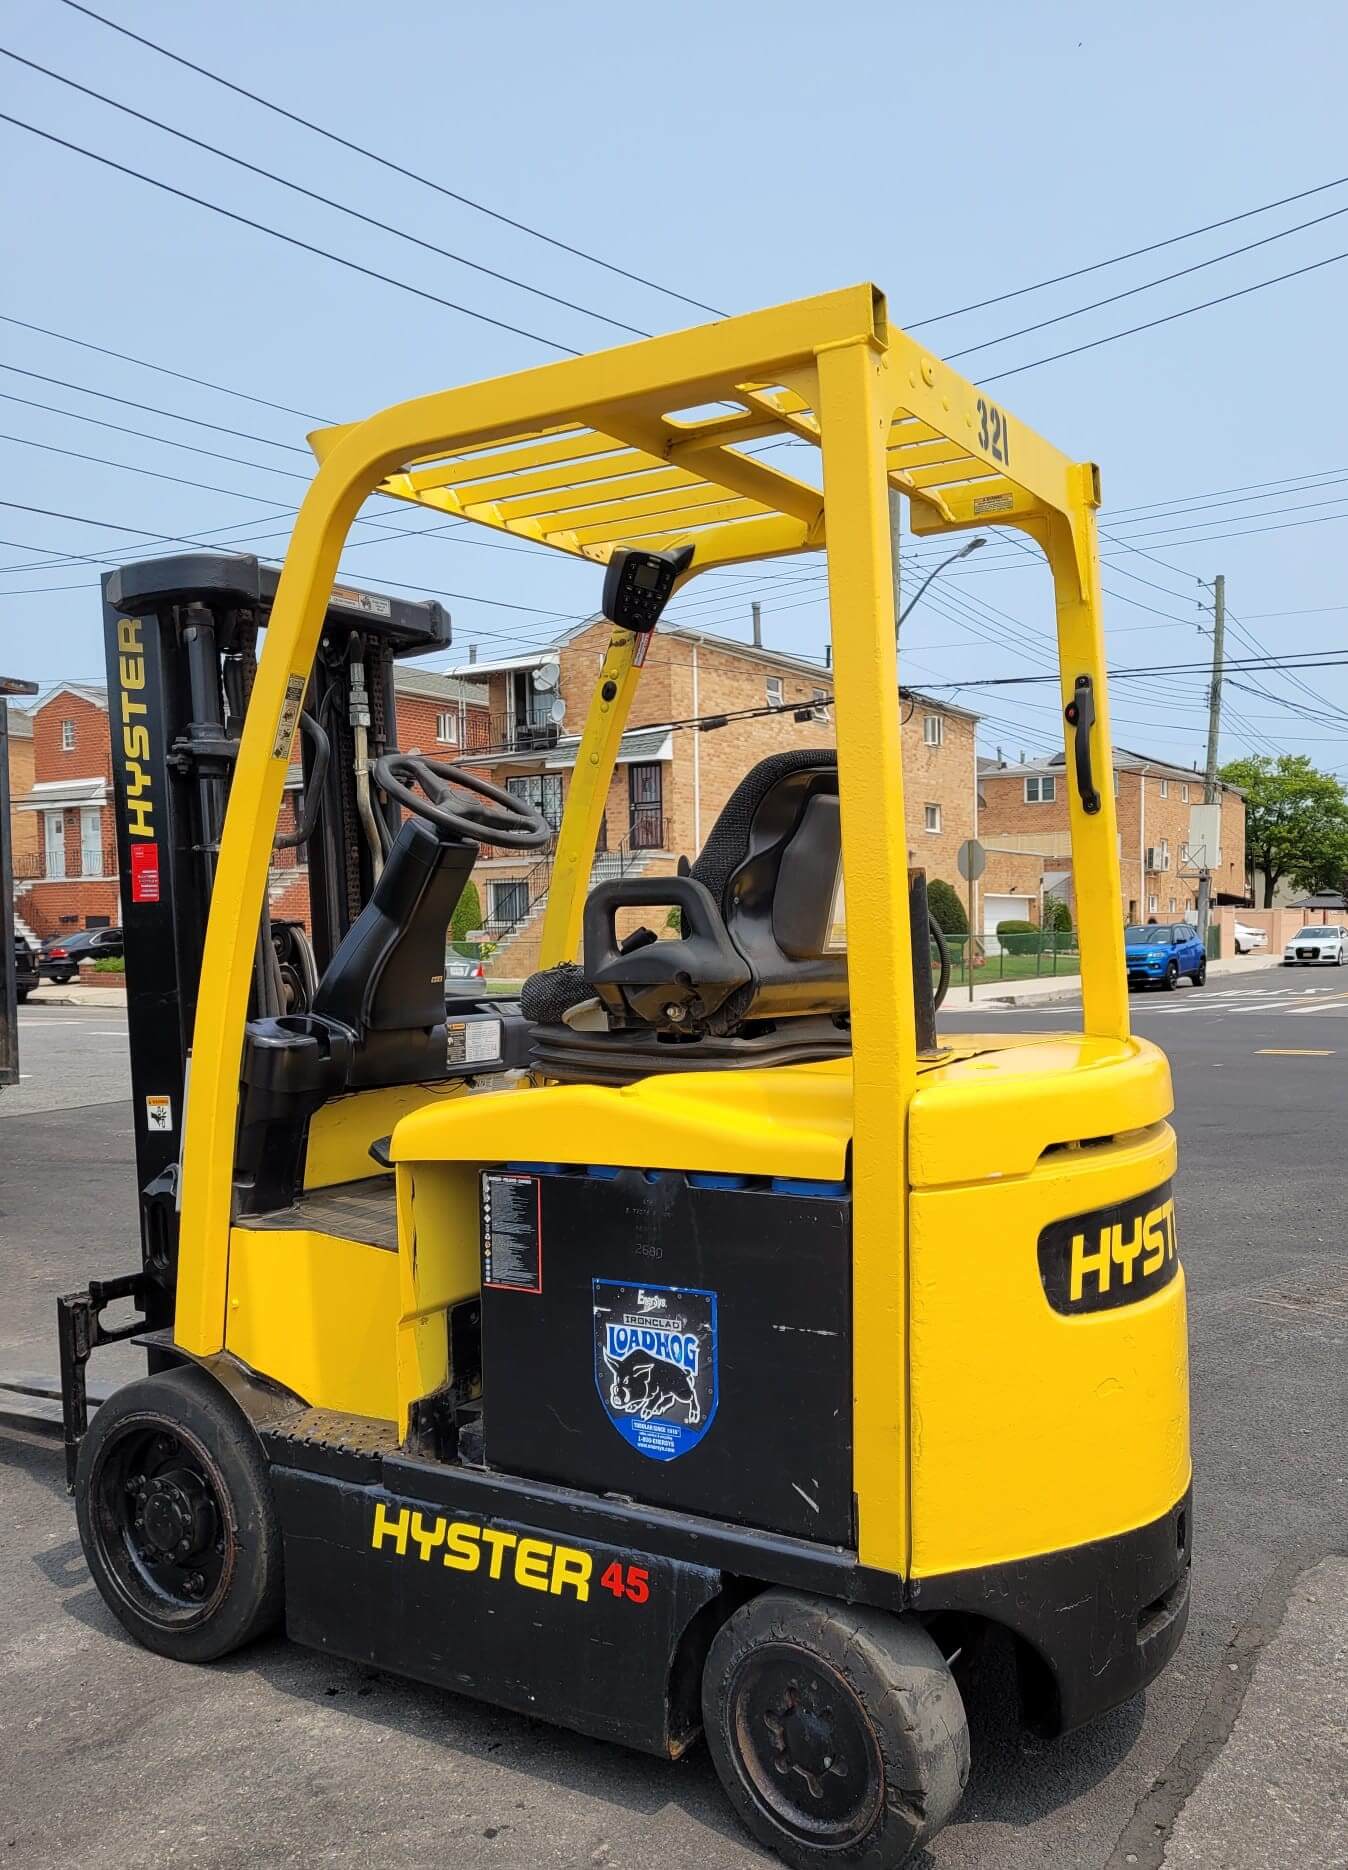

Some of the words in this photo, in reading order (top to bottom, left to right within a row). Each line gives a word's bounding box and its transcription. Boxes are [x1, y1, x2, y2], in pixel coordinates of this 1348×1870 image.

[976, 398, 1010, 467] 321
[117, 618, 155, 838] HYSTER
[1070, 1197, 1178, 1302] HYST
[624, 1315, 681, 1330] IRONCLAD
[637, 1289, 667, 1309] EnerSys
[606, 1323, 699, 1376] LOADHOG
[371, 1503, 593, 1602] HYSTER
[600, 1562, 650, 1604] 45
